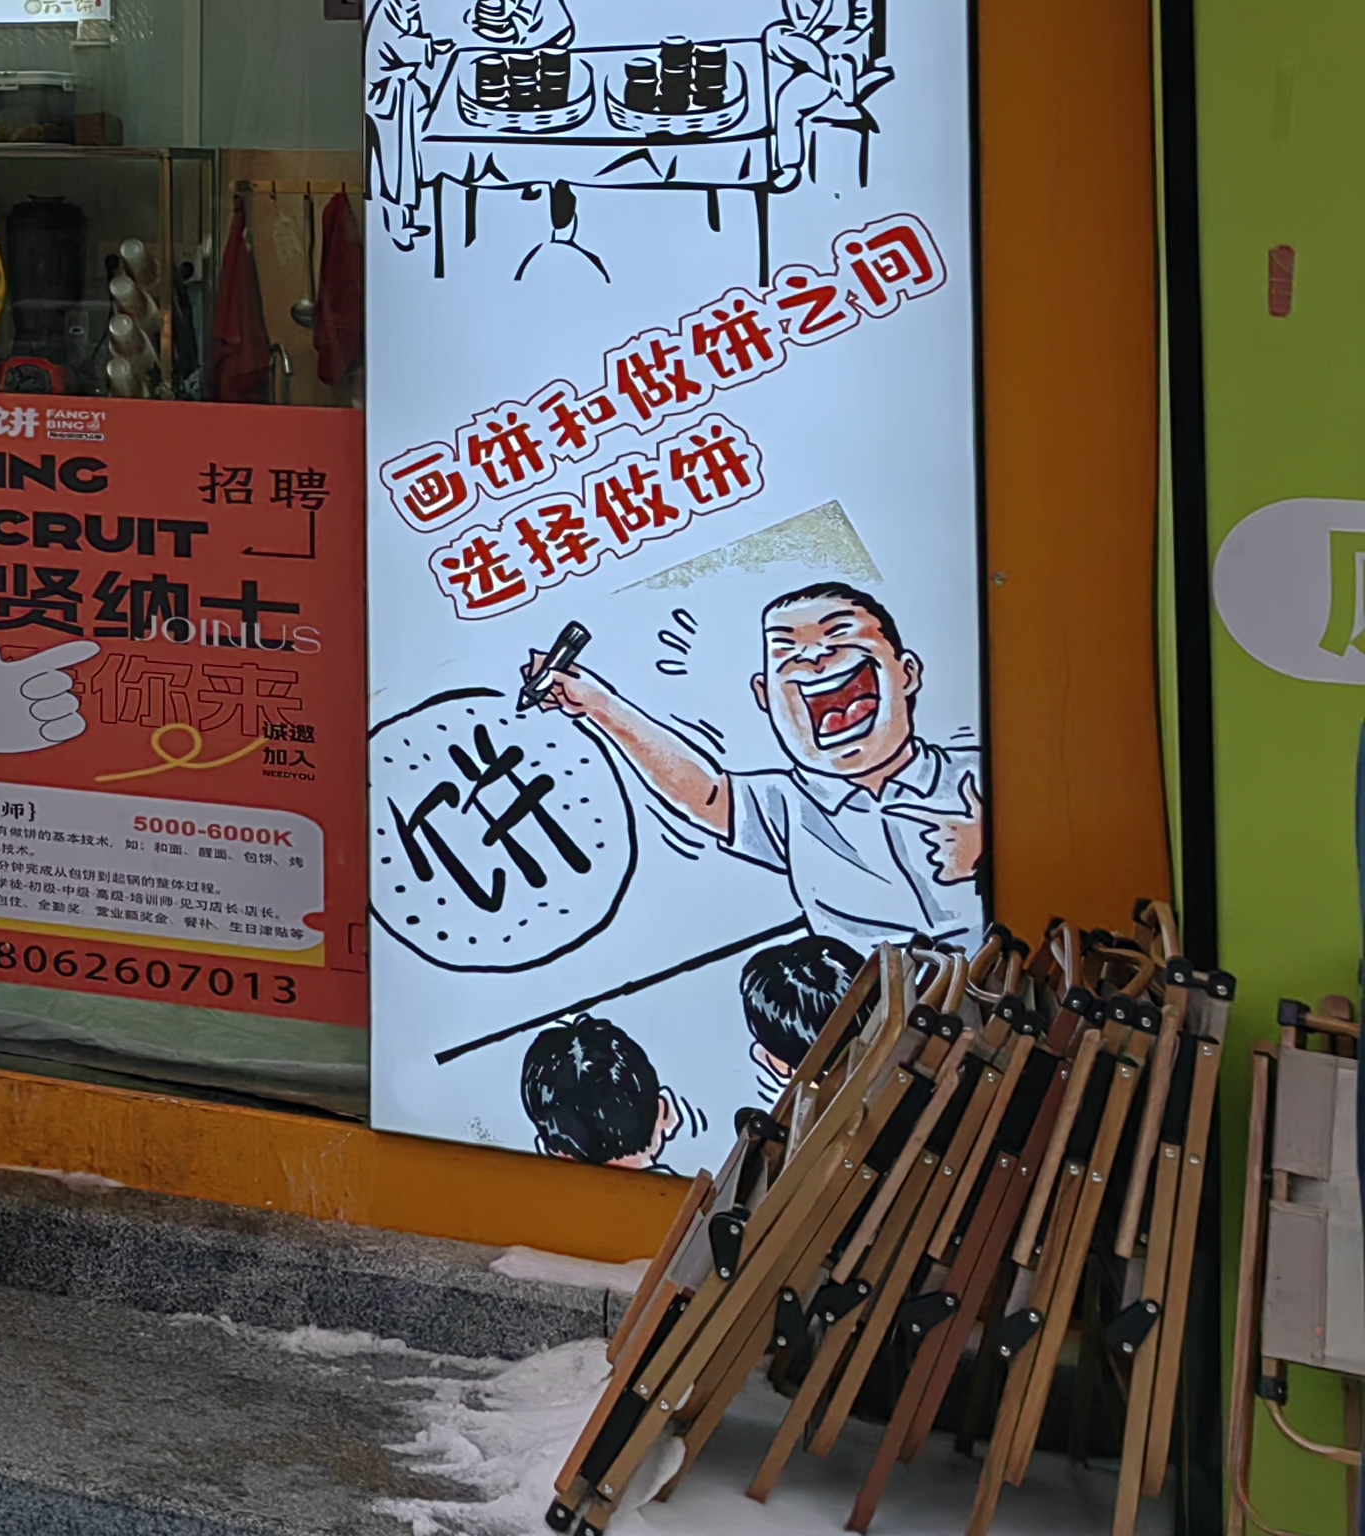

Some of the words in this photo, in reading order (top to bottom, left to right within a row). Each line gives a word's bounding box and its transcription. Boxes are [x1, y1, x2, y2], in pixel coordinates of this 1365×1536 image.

[392, 224, 934, 522] 画饼和做饼之间
[198, 462, 331, 511] 招聘
[441, 425, 755, 609] 选择做饼
[262, 720, 316, 744] 诚邀
[262, 746, 317, 770] 加入
[133, 815, 294, 848] 5000-6000K
[386, 724, 592, 912] 饼
